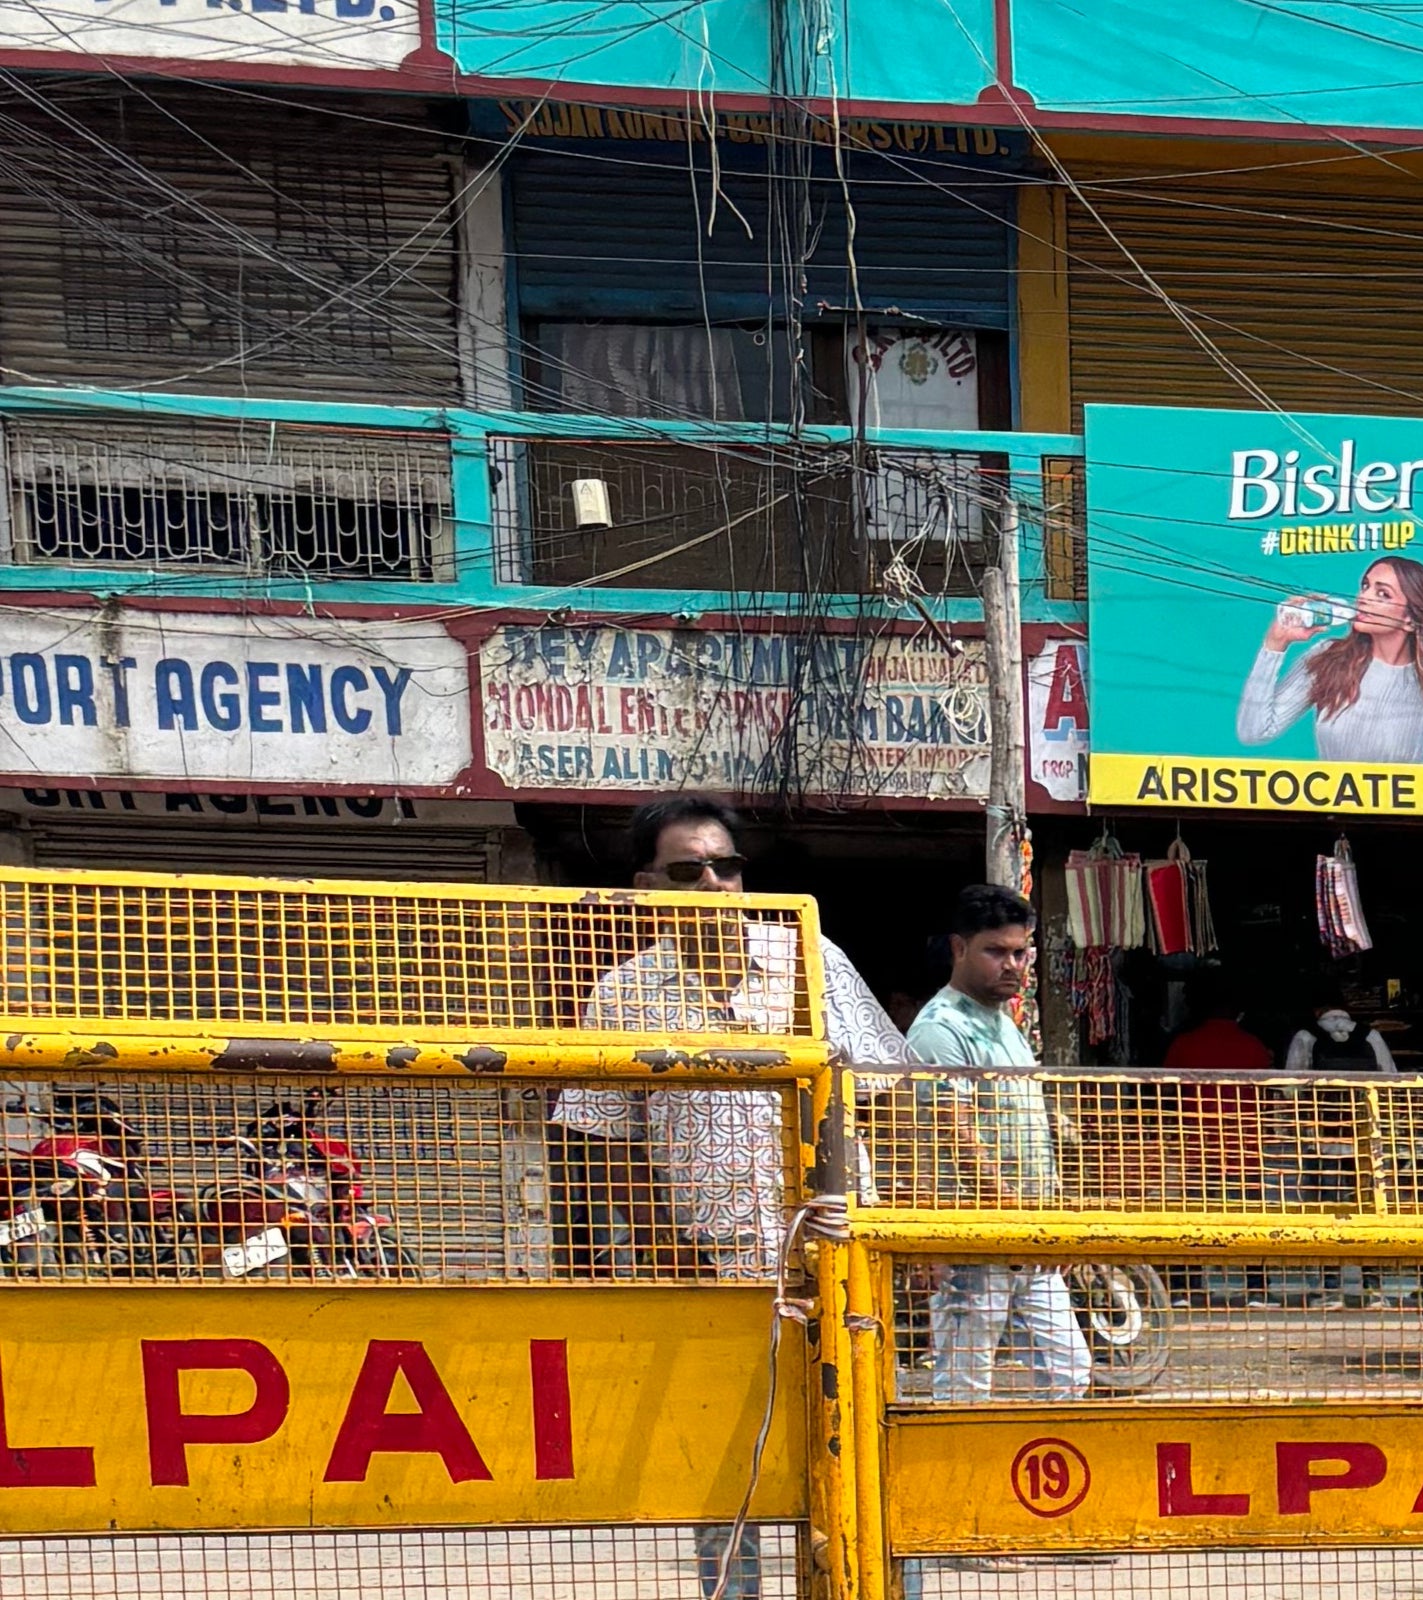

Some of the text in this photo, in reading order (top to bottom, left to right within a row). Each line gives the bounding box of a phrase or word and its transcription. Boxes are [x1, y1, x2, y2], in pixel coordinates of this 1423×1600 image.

[1261, 521, 1416, 556] #DRINKITUP
[0, 652, 415, 737] ORT AGENCY
[487, 681, 613, 735] MONDAL
[1138, 764, 1414, 809] ARISTOCATE
[1022, 1452, 1070, 1501] 19
